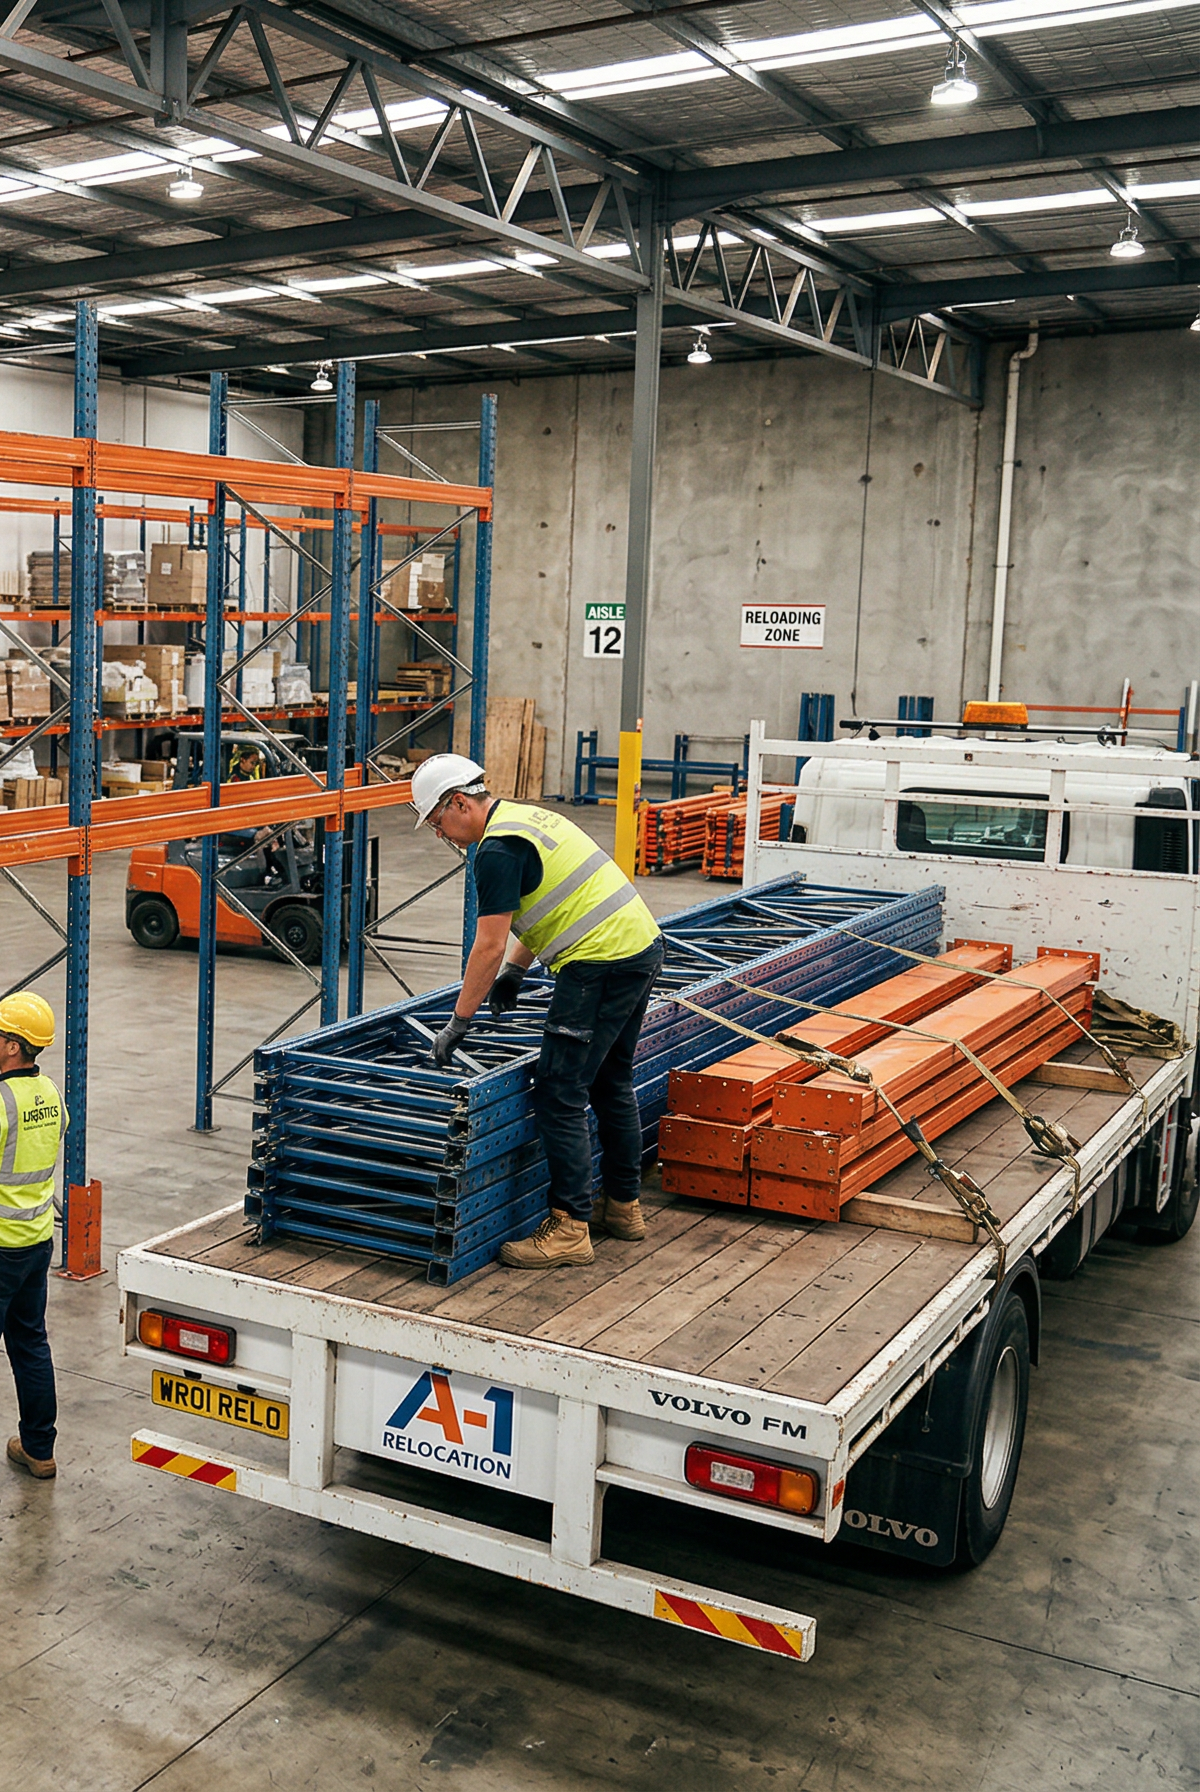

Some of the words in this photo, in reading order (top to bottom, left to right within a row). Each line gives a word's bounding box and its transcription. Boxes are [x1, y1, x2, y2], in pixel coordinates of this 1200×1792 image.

[587, 605, 625, 620] AISLE
[745, 611, 822, 625] RELOADING
[588, 625, 622, 655] 12
[764, 628, 801, 642] ZONE
[218, 1392, 281, 1431] RELO
[385, 1369, 515, 1457] A-1
[647, 1389, 752, 1426] VOLVO
[762, 1416, 807, 1440] FM
[382, 1431, 512, 1480] RELOCATION
[844, 1509, 939, 1547] OLVO
